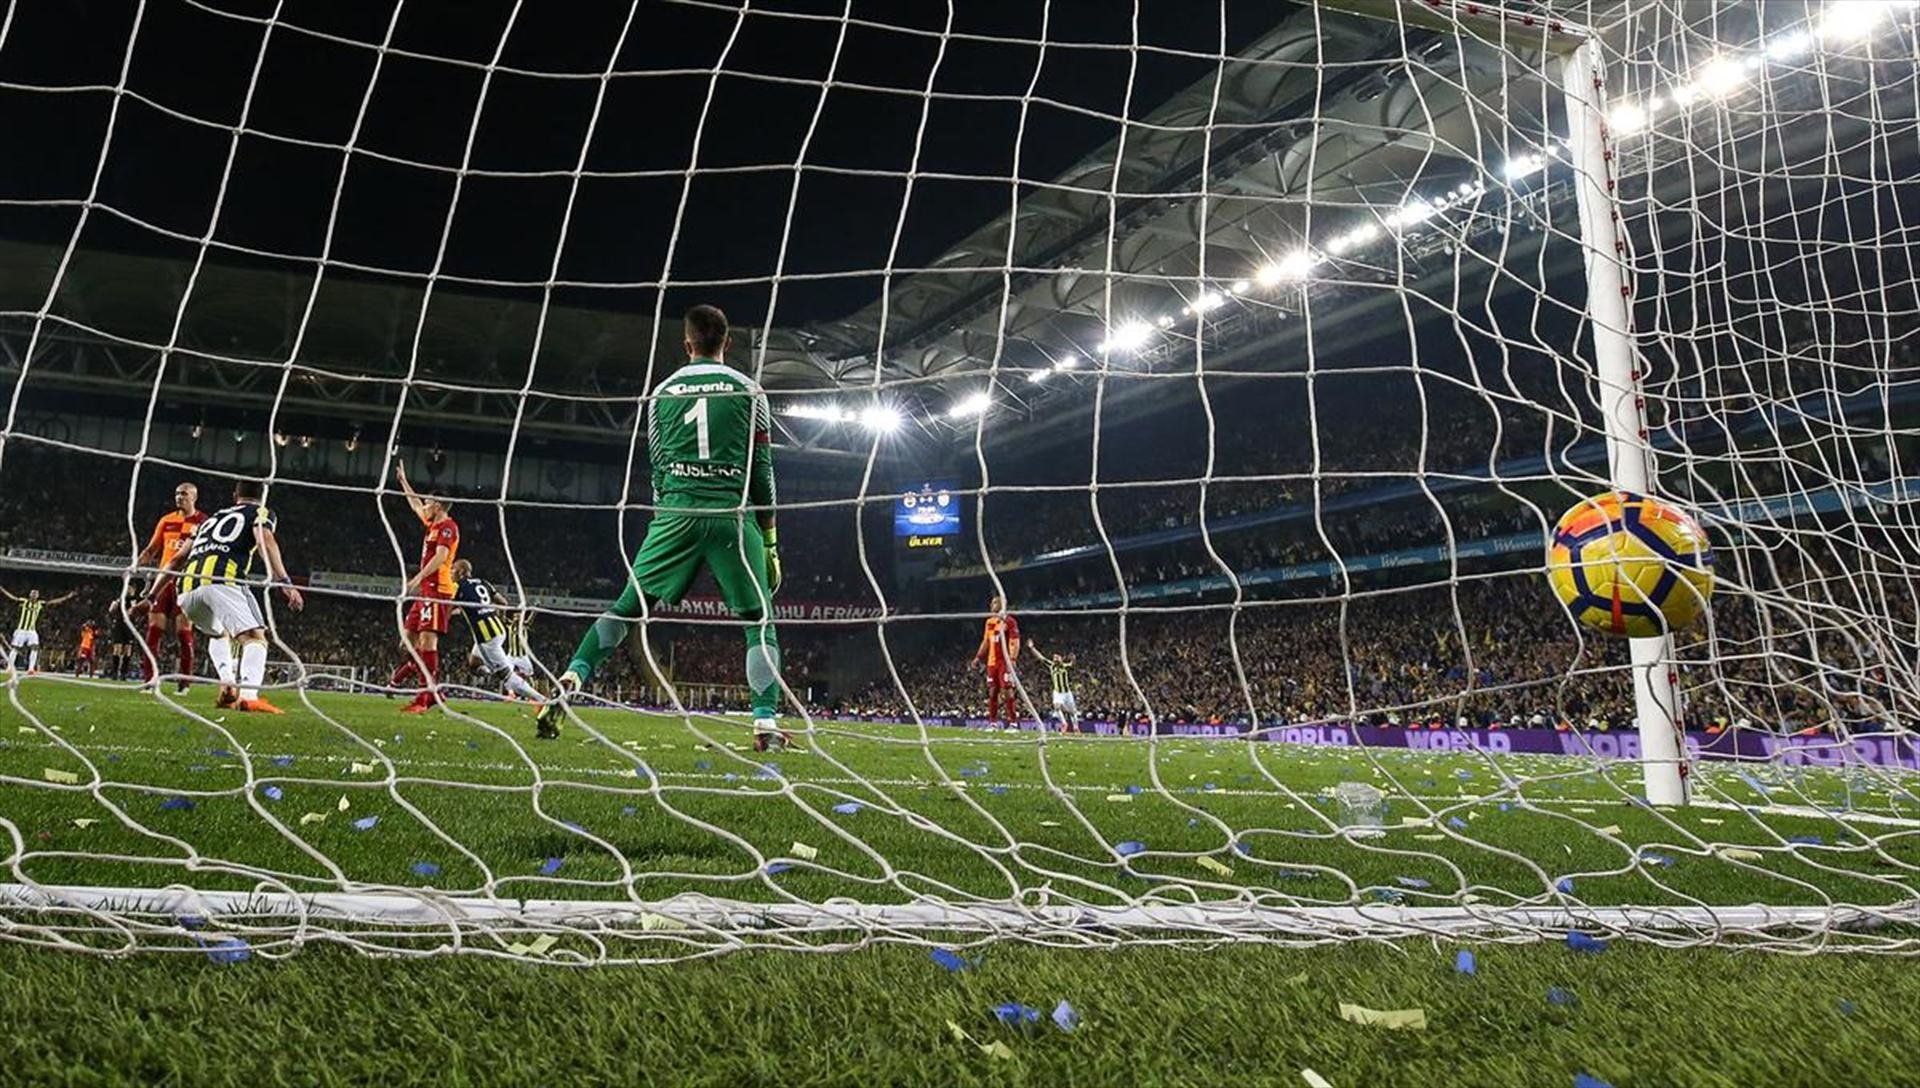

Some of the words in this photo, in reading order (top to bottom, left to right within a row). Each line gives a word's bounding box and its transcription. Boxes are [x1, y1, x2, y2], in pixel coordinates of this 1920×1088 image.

[679, 381, 734, 394] Garenta
[684, 397, 710, 460] 1
[193, 512, 245, 549] 20
[475, 584, 491, 606] 9
[420, 607, 433, 620] 14
[1095, 723, 1149, 736] WOLD
[1173, 725, 1239, 738] WORLD
[1268, 728, 1348, 745] WORLD
[1404, 730, 1511, 752] WORLD
